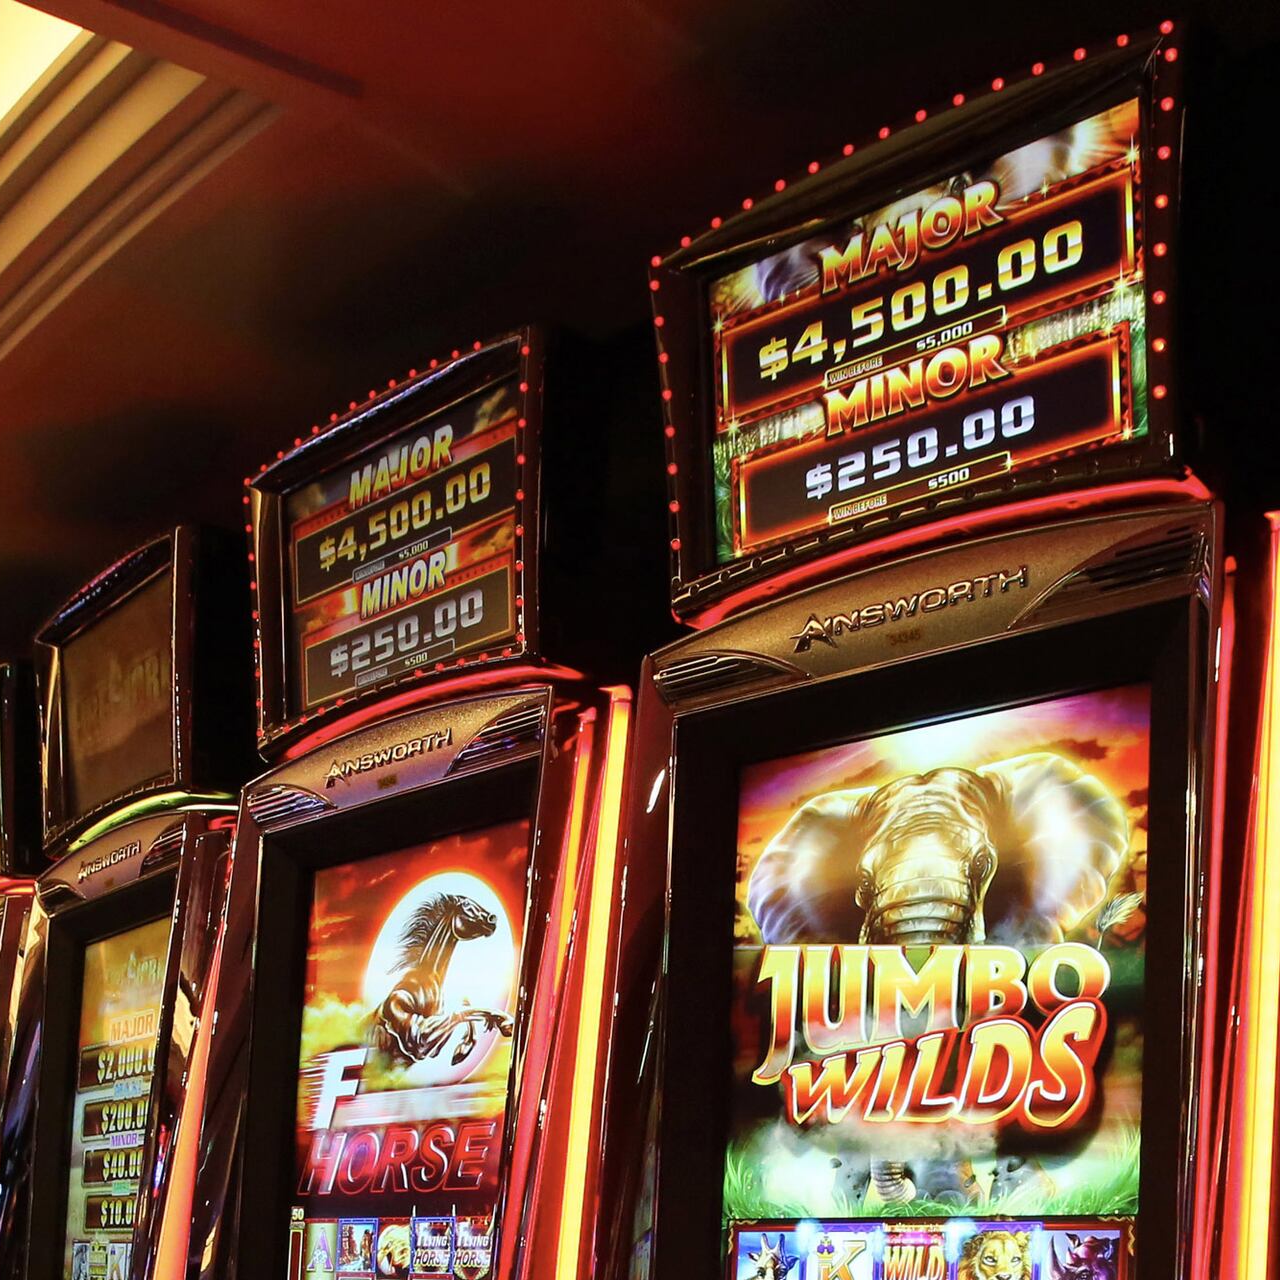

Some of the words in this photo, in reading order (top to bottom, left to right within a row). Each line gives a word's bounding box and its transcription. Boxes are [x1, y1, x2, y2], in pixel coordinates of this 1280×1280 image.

[819, 181, 1004, 294] MAJOR
[759, 220, 1083, 380] $4,500.00
[916, 321, 973, 351] $5,000
[824, 334, 1009, 437] MINOR
[349, 424, 453, 509] MAJOR
[806, 395, 1035, 499] $250.00
[928, 468, 970, 490] $500
[320, 462, 491, 572] $4,500.00
[361, 551, 446, 620] MINOR
[790, 565, 1028, 654] AINSWORTH
[330, 589, 483, 678] $250.00
[404, 652, 427, 667] $500
[323, 727, 453, 789] AINSWORTH
[110, 1012, 154, 1042] MAJOR
[751, 942, 1112, 1086] JUMBO
[785, 1000, 1105, 1131] WILDS
[297, 1121, 496, 1197] HORSE
[291, 1208, 305, 1221] 50
